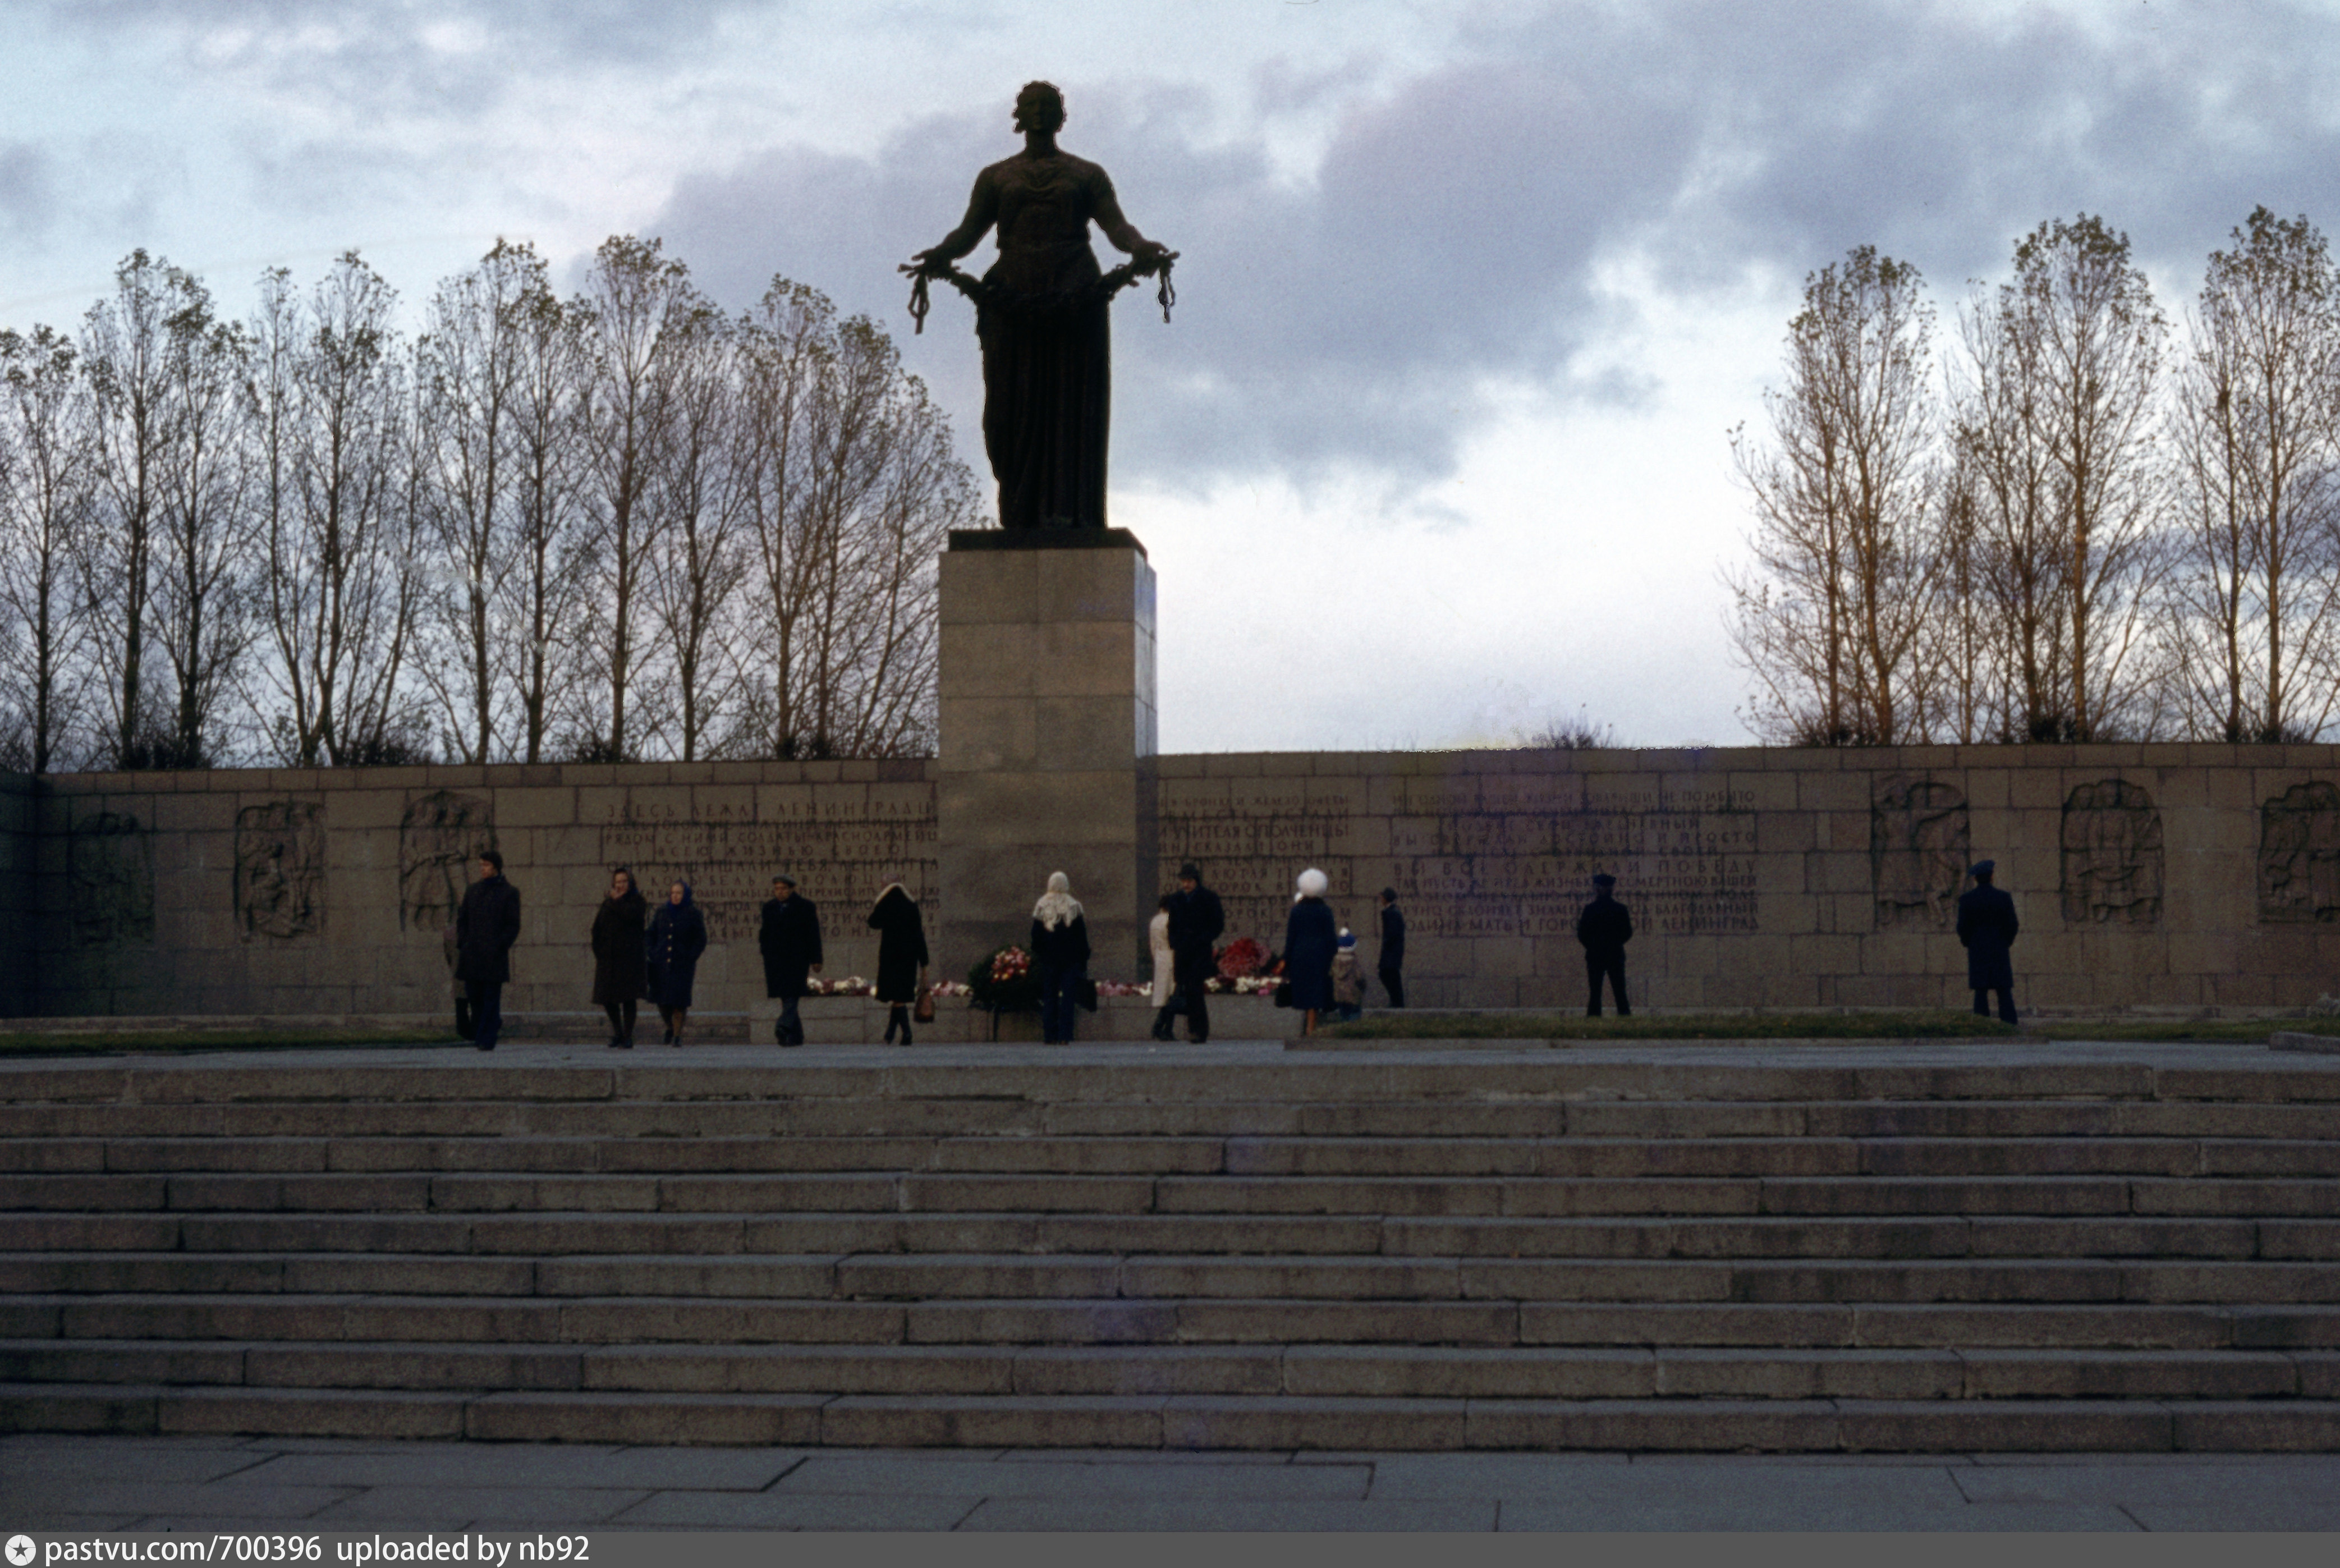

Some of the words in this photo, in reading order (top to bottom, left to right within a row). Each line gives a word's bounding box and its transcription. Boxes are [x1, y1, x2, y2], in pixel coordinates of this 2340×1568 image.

[607, 804, 675, 818] ЗДЕСЬ
[1658, 860, 1756, 873] ПОБЕДУ
[1661, 916, 1759, 930] ЛЕНИНГРАД
